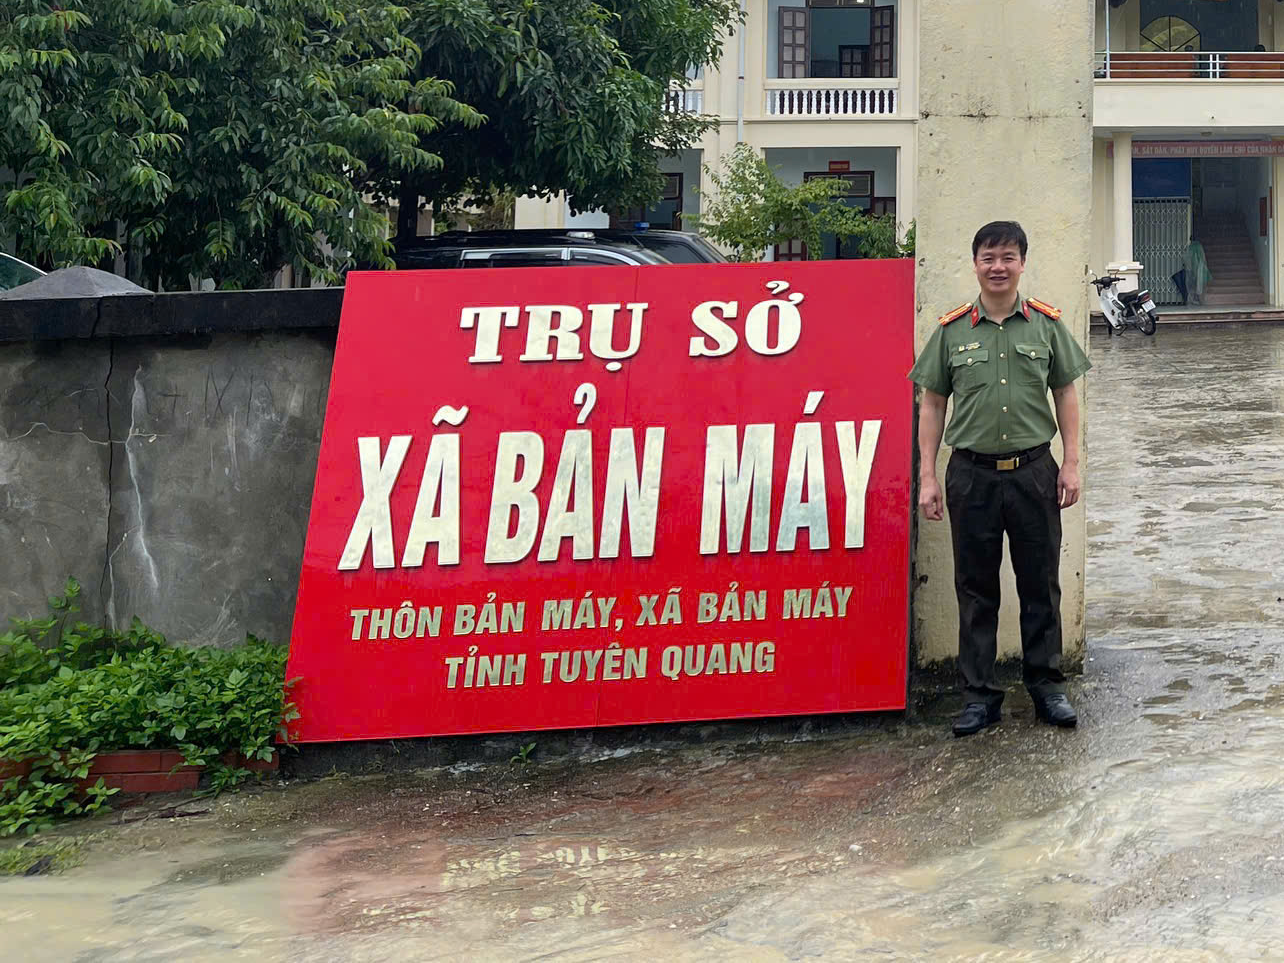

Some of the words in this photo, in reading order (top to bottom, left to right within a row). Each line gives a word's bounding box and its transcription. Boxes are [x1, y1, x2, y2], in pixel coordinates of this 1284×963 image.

[459, 301, 649, 372] TRỤ
[688, 280, 806, 358] SỞ
[336, 403, 470, 571] XÃ
[483, 382, 667, 565] BẢN
[698, 390, 883, 556] MÁY
[349, 599, 443, 642] THÔN
[452, 591, 526, 636] BẢN
[540, 590, 624, 632] MÁY,
[635, 585, 684, 627] XÃ
[696, 580, 768, 623] BẢN
[782, 580, 854, 620] MÁY
[444, 641, 527, 690] TỈNH
[540, 641, 649, 684] TUYÊN
[660, 639, 777, 680] QUANG
